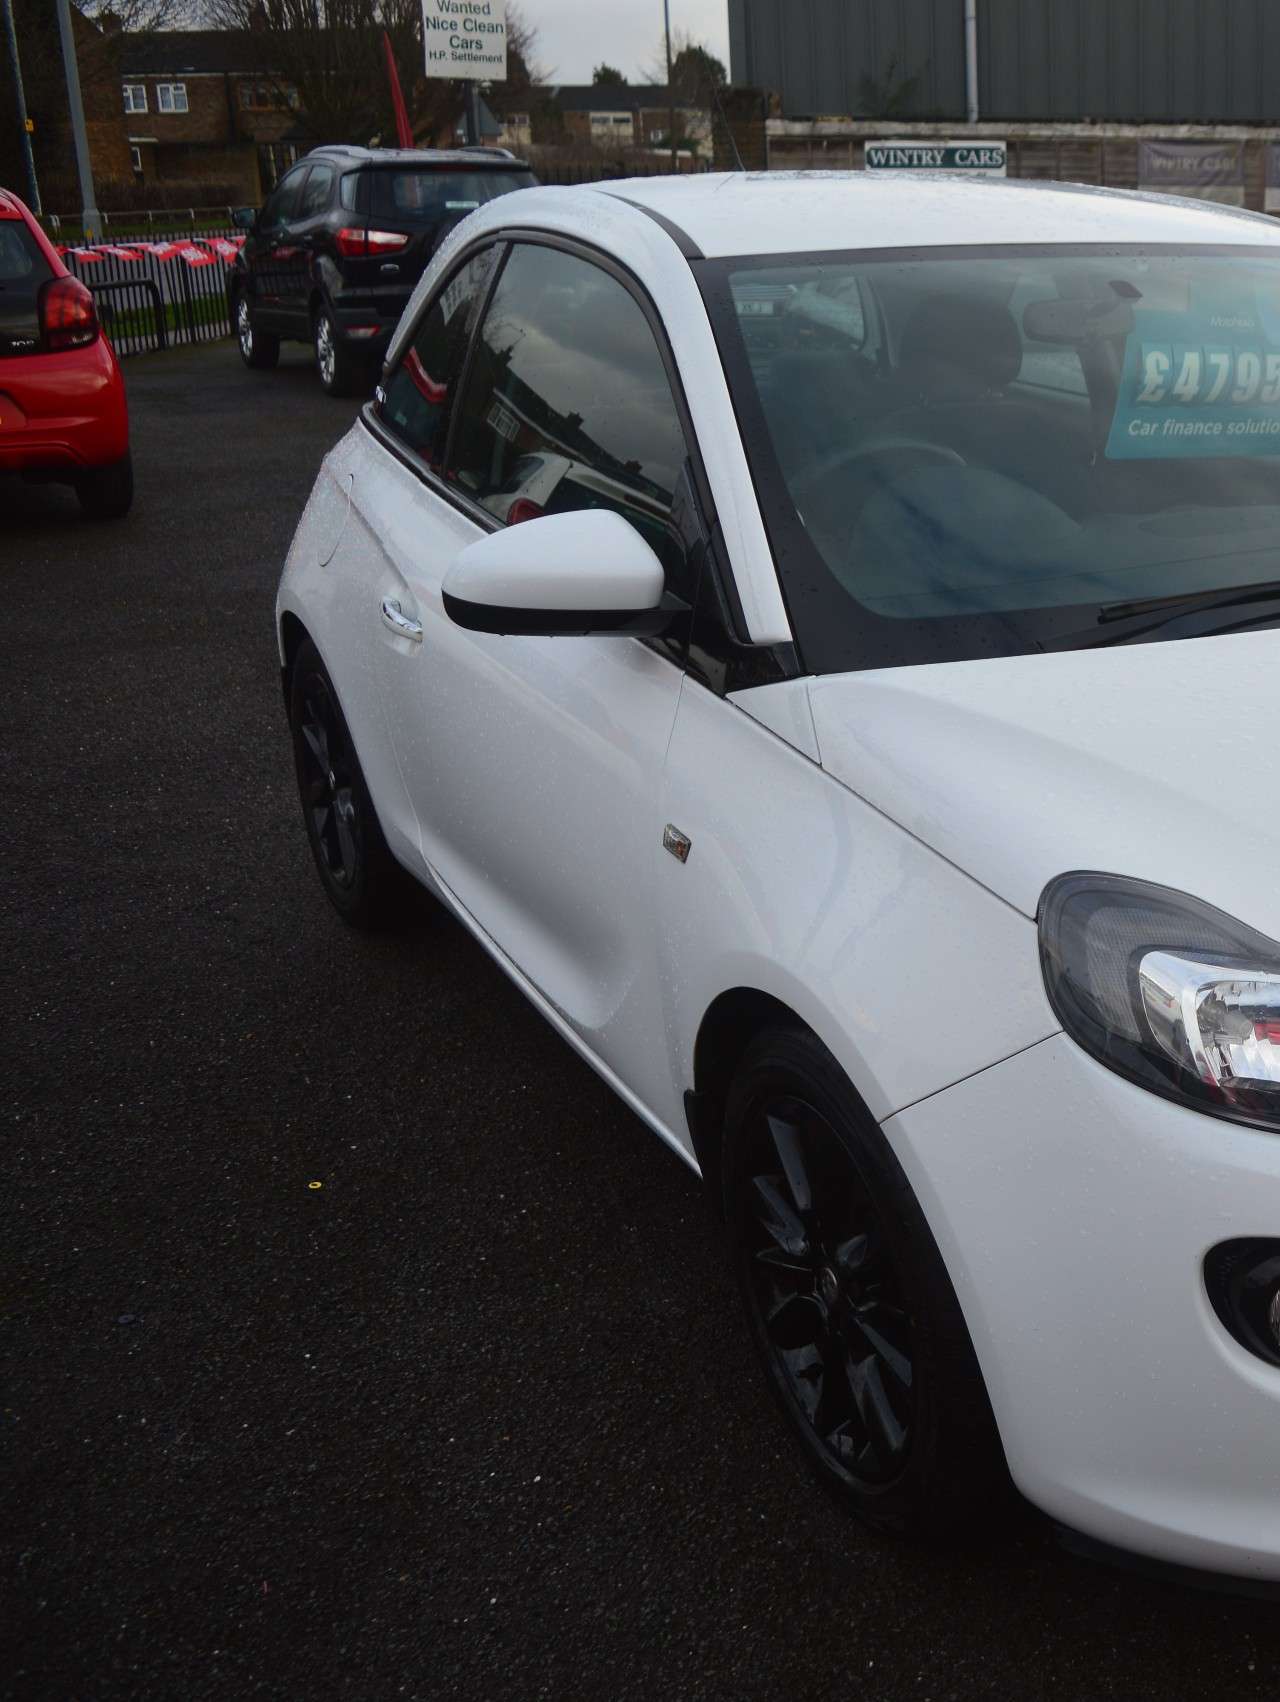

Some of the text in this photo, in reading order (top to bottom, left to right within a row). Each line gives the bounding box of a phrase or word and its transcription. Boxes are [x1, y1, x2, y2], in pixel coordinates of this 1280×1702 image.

[436, 0, 491, 15] Wanted
[426, 16, 504, 33] Nice Clean
[449, 34, 483, 50] Cars
[451, 51, 503, 63] Settlement
[869, 149, 1003, 166] WINTRY CARS
[1128, 418, 1159, 436] Car
[1162, 418, 1223, 437] finance
